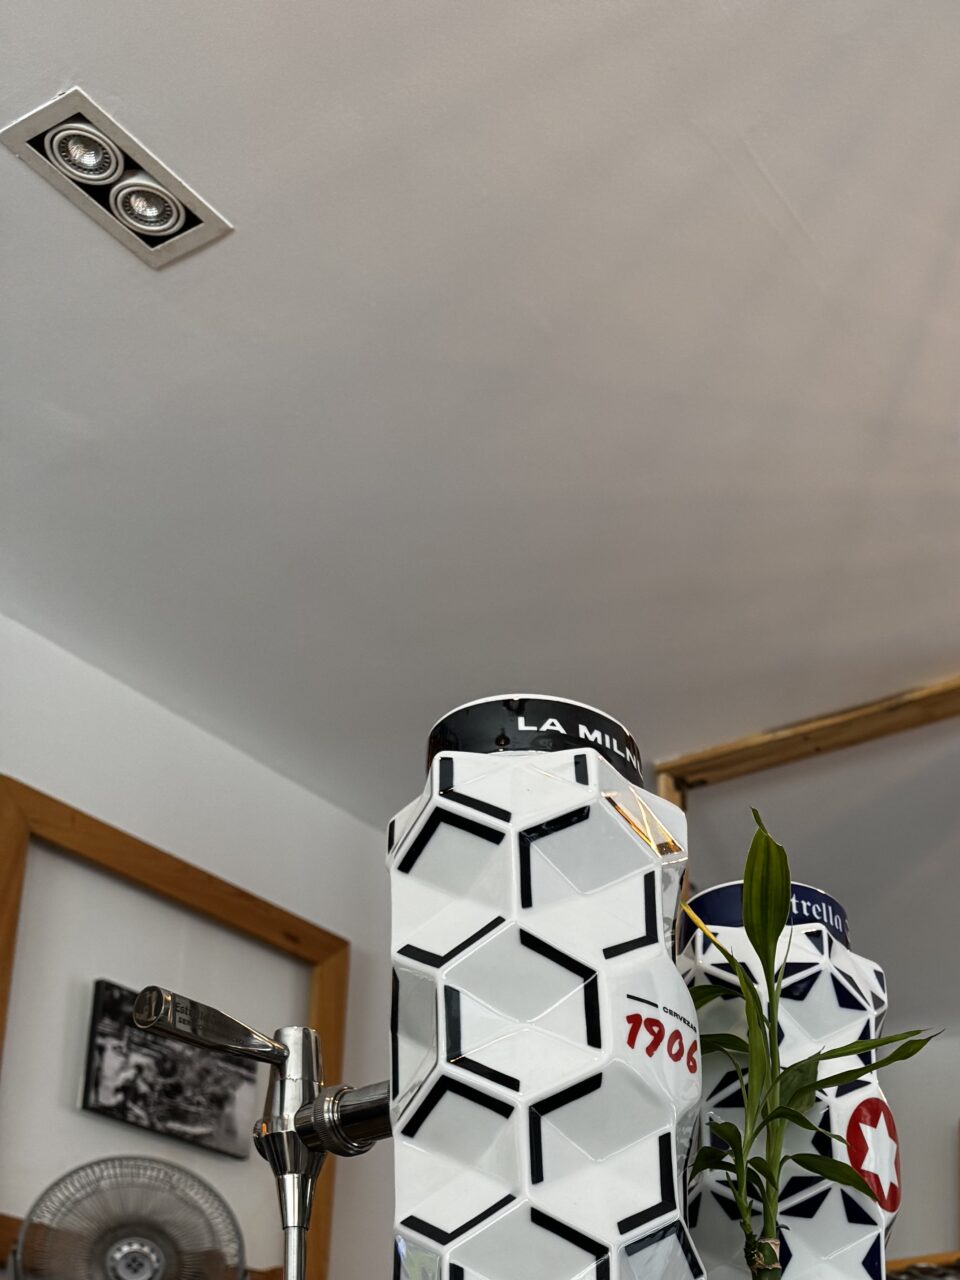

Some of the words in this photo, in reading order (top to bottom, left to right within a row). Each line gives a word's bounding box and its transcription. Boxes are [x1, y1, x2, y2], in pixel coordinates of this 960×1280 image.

[517, 716, 567, 735] LA
[578, 723, 643, 780] MILN
[789, 893, 843, 933] trella
[625, 1013, 698, 1074] 1906
